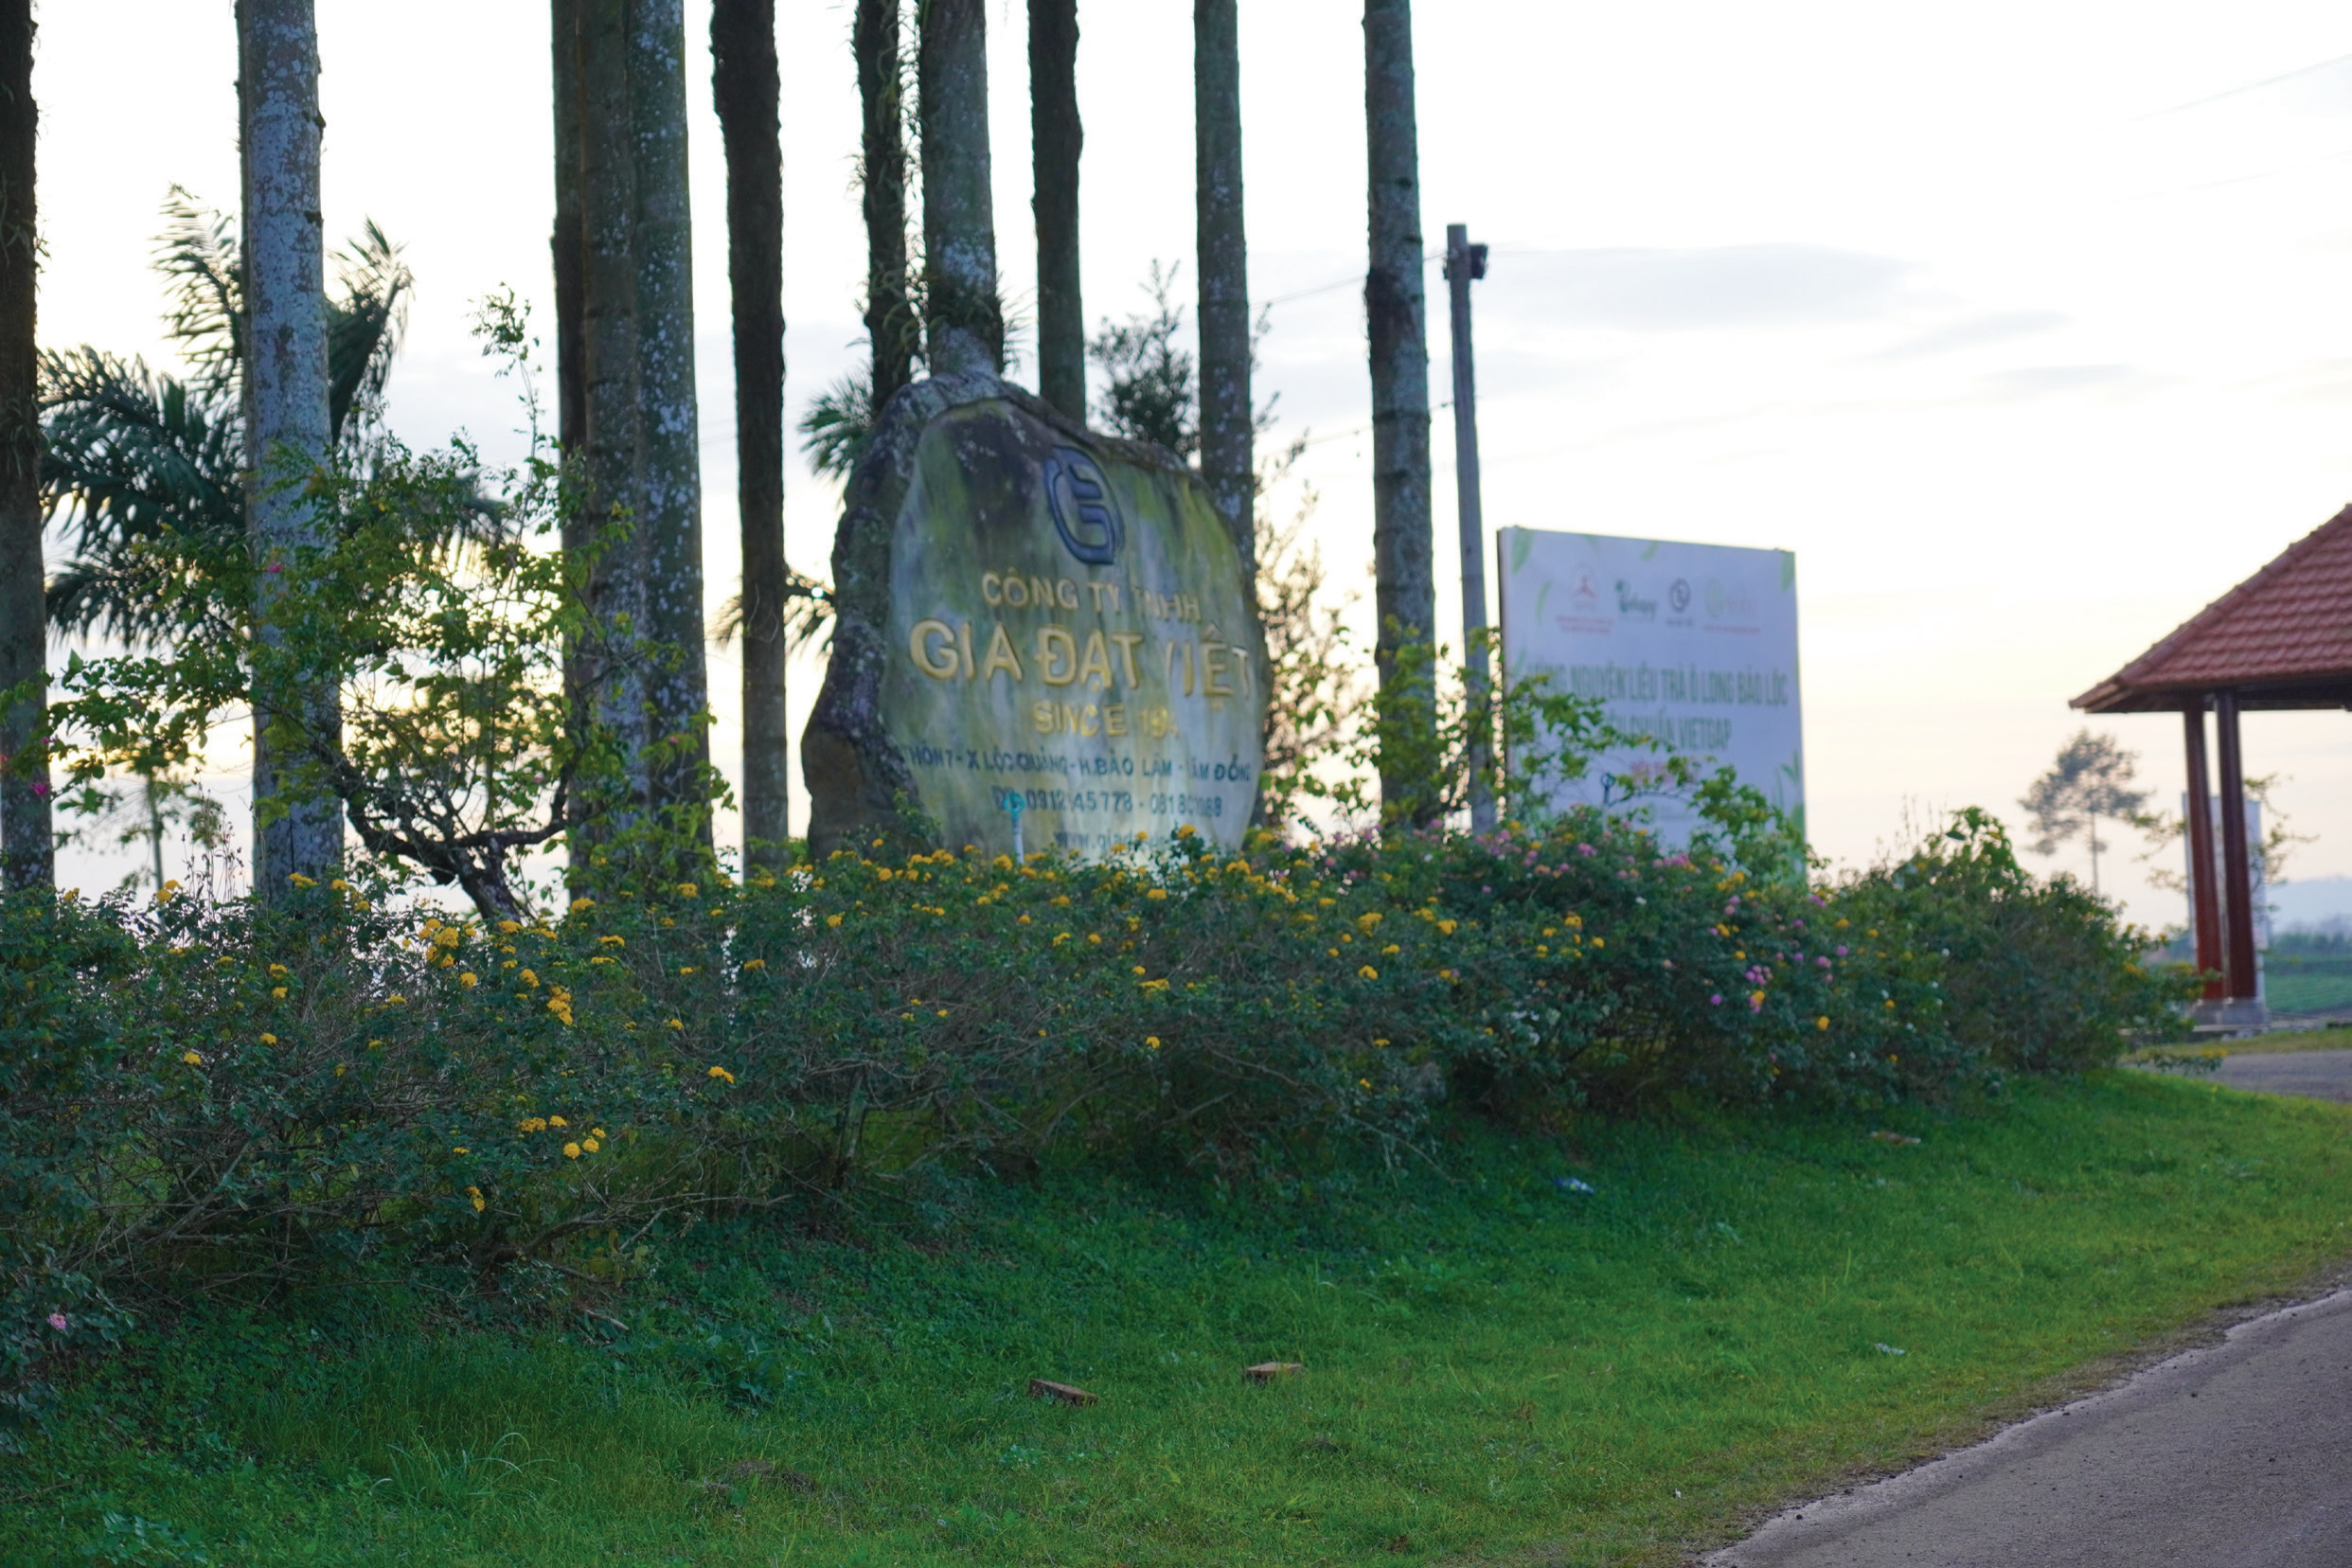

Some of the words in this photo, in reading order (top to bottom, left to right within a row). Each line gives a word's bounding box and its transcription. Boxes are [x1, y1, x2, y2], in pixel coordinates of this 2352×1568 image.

[981, 567, 1078, 611] CÔNG
[1087, 581, 1121, 614] TY
[909, 617, 1023, 681] GIA
[1035, 623, 1144, 692] ĐẠT
[1032, 700, 1129, 738] SINCE
